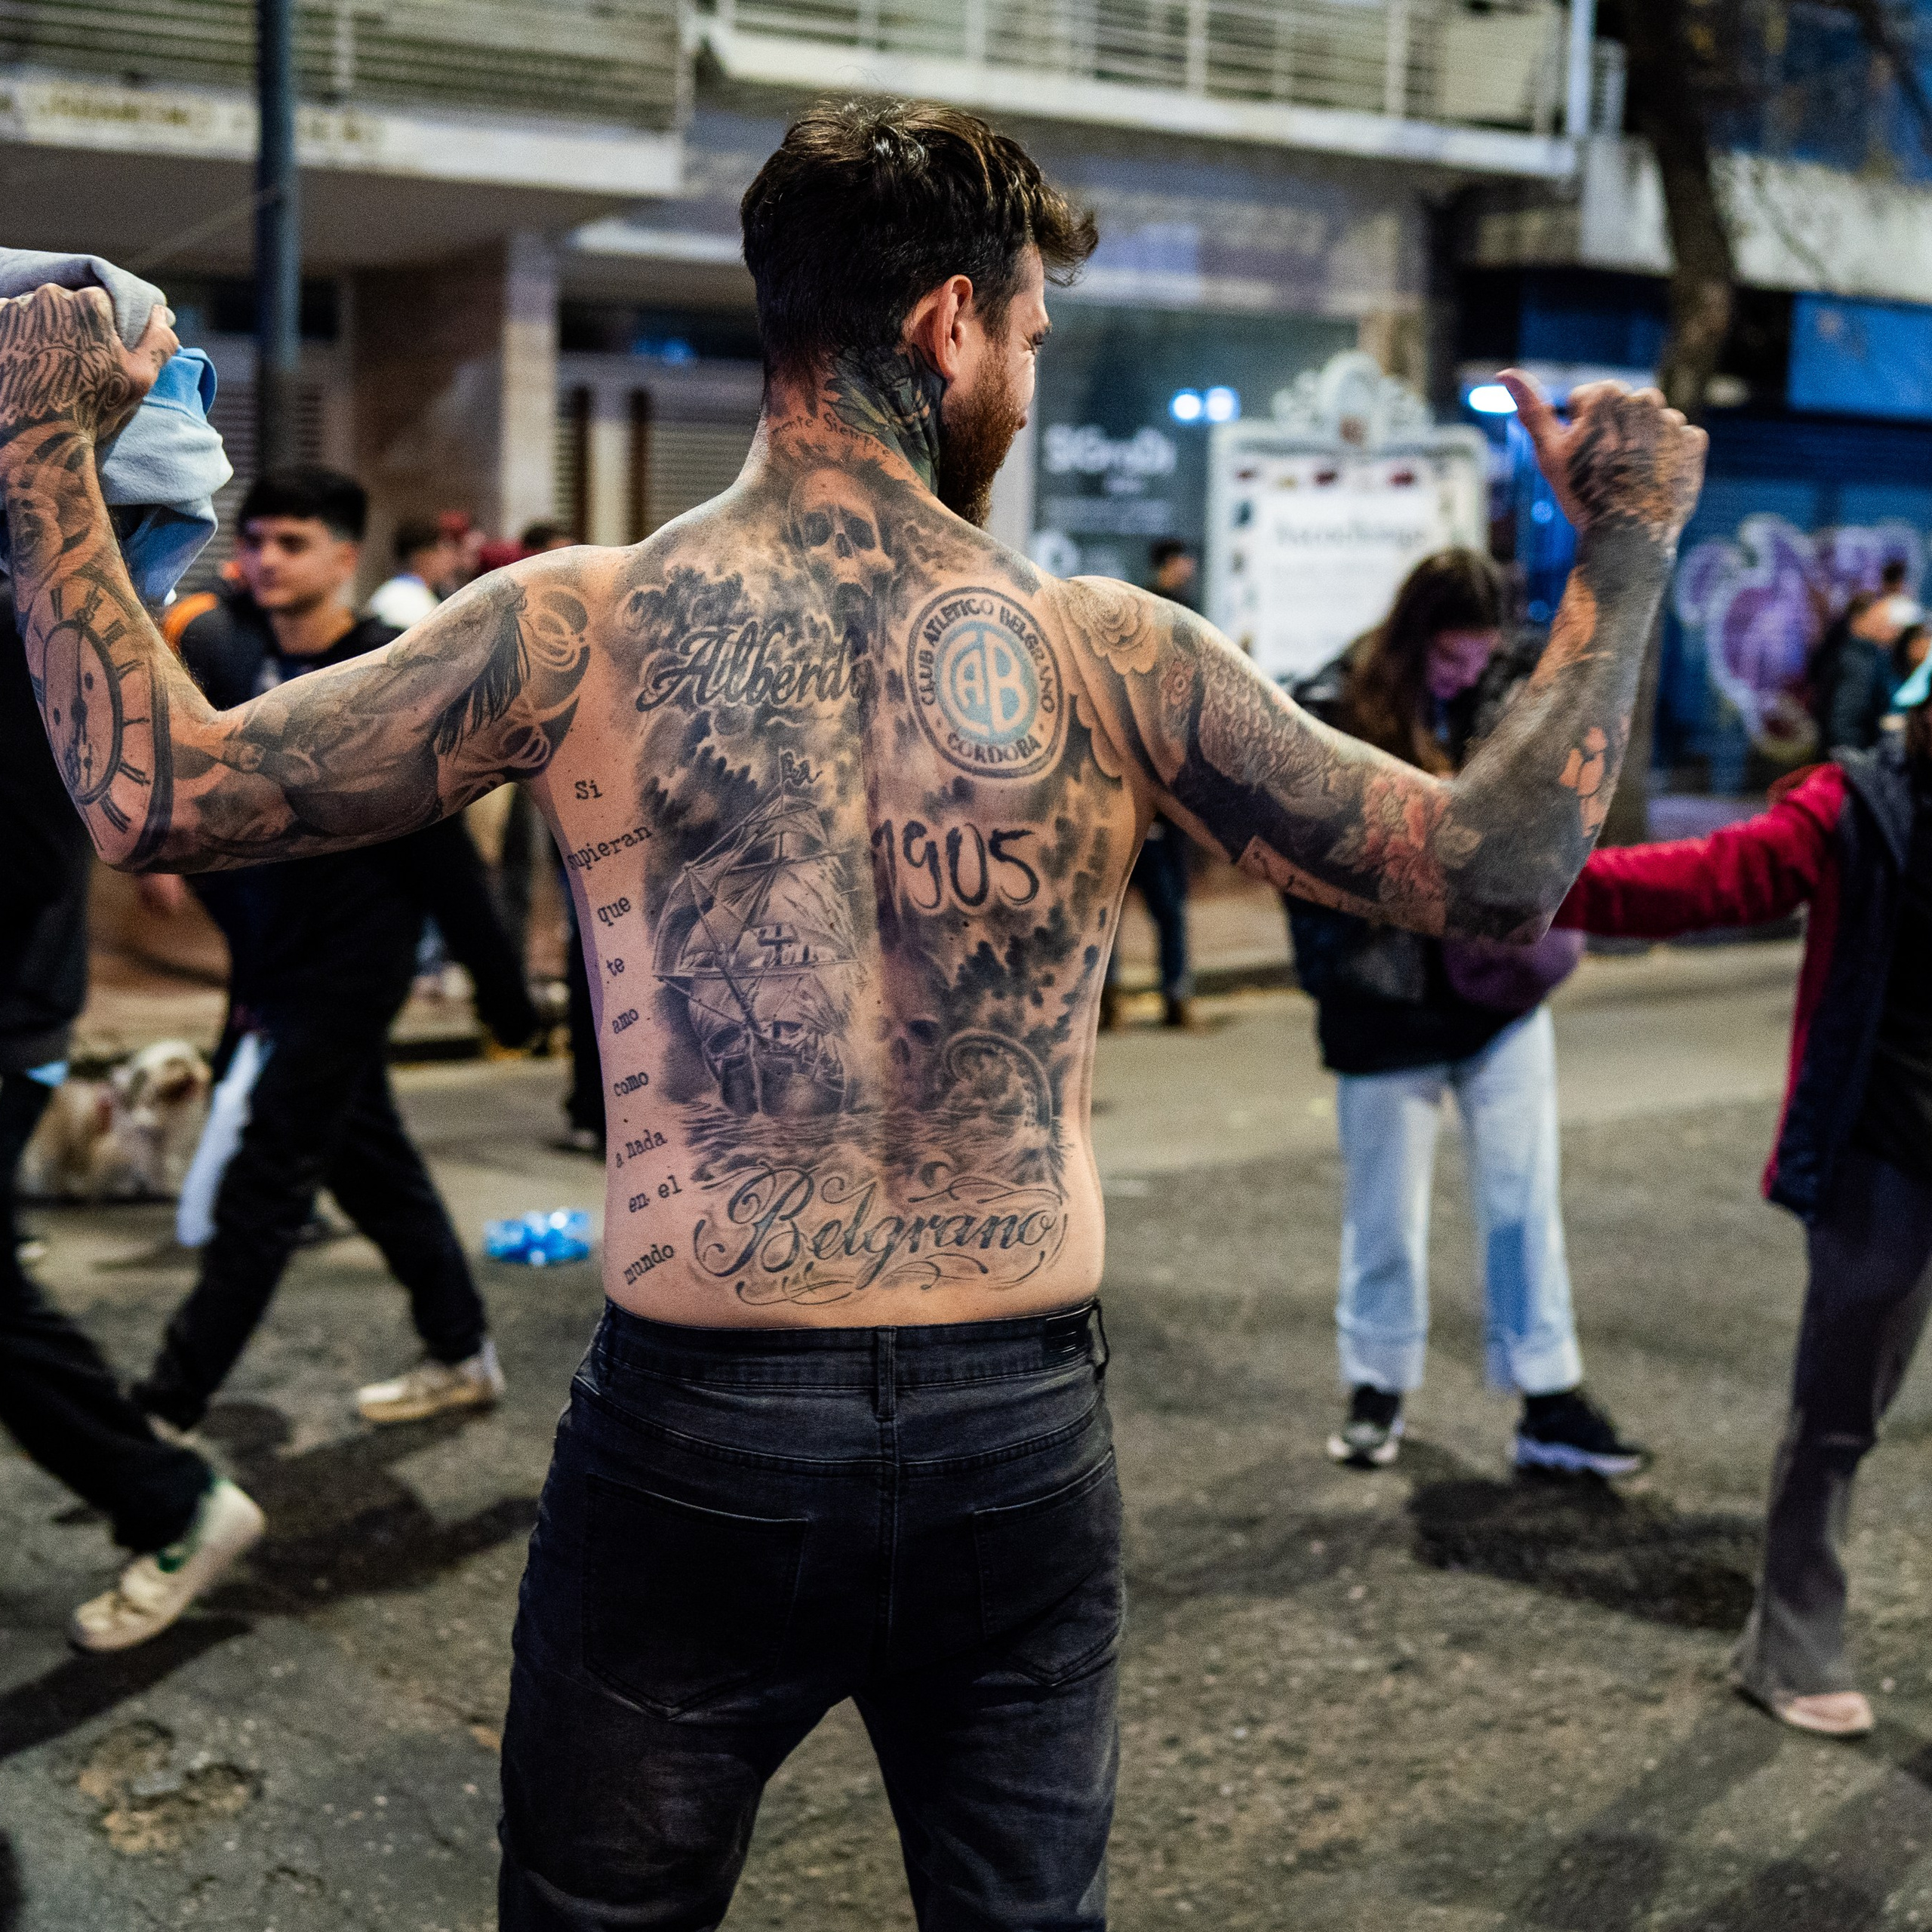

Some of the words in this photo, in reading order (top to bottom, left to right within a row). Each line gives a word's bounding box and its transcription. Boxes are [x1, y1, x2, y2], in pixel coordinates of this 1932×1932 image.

[922, 598, 995, 647] ATLETICO
[918, 649, 935, 706] CLUB
[1000, 605, 1056, 714] BELGRANO
[947, 731, 1042, 764] CORDOBA
[574, 779, 603, 800] Si
[567, 826, 653, 870] supieran
[871, 819, 1040, 909] 1905
[597, 896, 632, 927] que
[606, 956, 625, 977] te
[611, 1008, 639, 1035] amo
[613, 1070, 649, 1097] como
[626, 1129, 668, 1159] nada
[628, 1191, 651, 1214] en
[657, 1175, 682, 1199] el
[693, 1166, 1057, 1291] Belgrano
[623, 1244, 675, 1286] mundo
